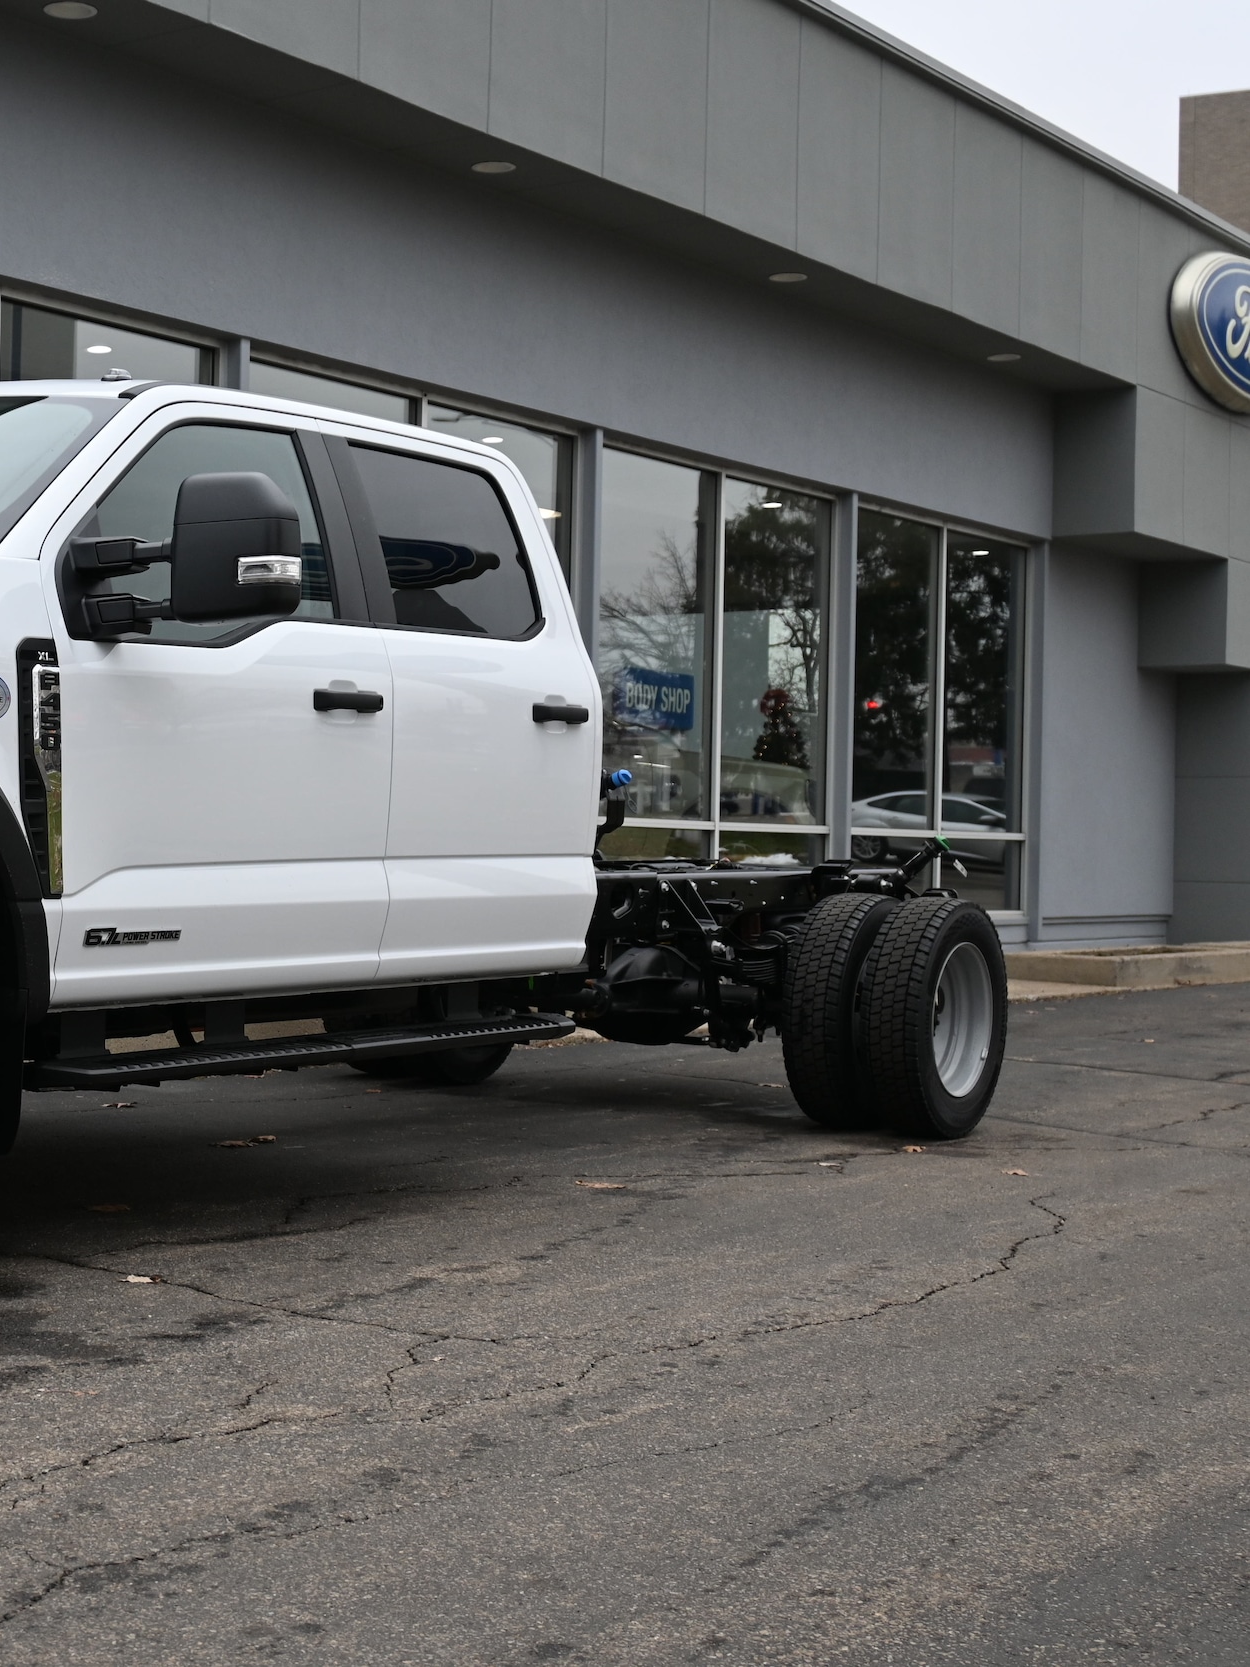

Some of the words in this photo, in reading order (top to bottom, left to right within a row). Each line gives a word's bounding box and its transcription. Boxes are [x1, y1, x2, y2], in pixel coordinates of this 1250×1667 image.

[37, 651, 54, 661] XL
[626, 682, 658, 711] BODY
[661, 686, 691, 714] SHOP
[85, 927, 121, 946] 6.7L
[123, 931, 150, 941] POWER
[150, 930, 180, 940] STROKE
